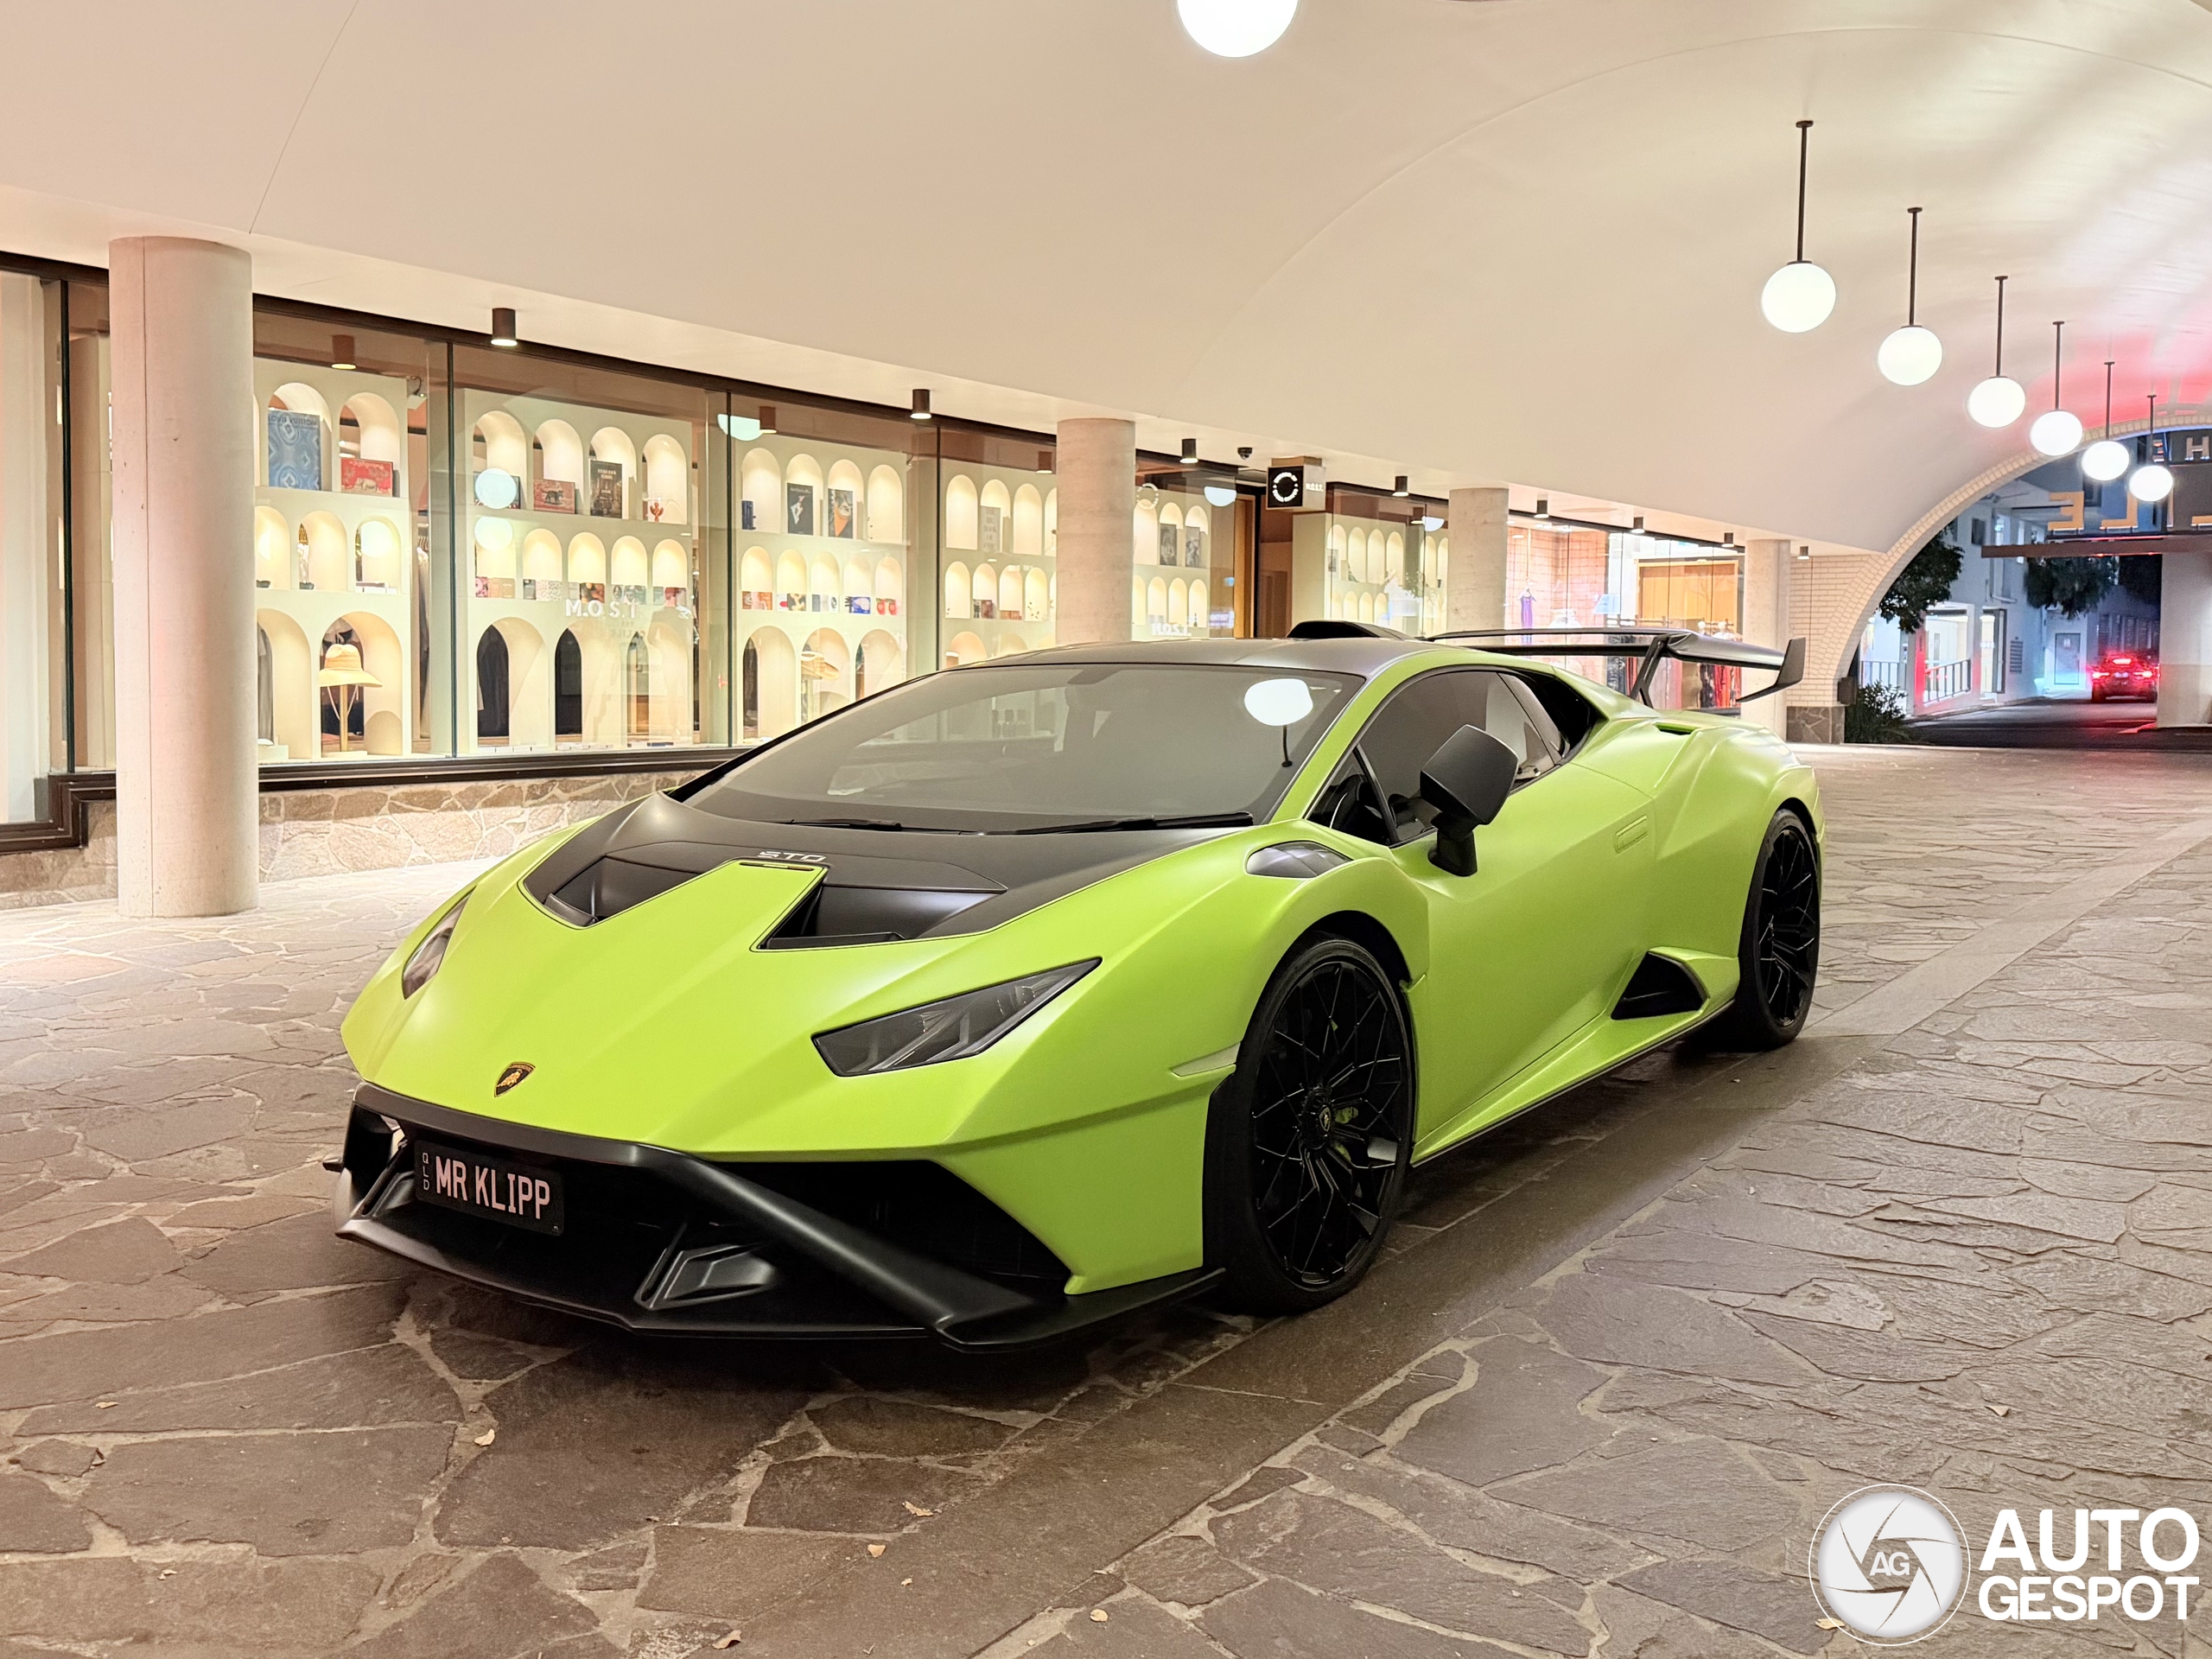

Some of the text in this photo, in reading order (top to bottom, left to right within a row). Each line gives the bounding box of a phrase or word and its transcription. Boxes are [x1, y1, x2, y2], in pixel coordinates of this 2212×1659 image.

[758, 850, 826, 862] STO
[422, 1152, 430, 1192] QLD
[435, 1155, 551, 1219] MR KLIPP
